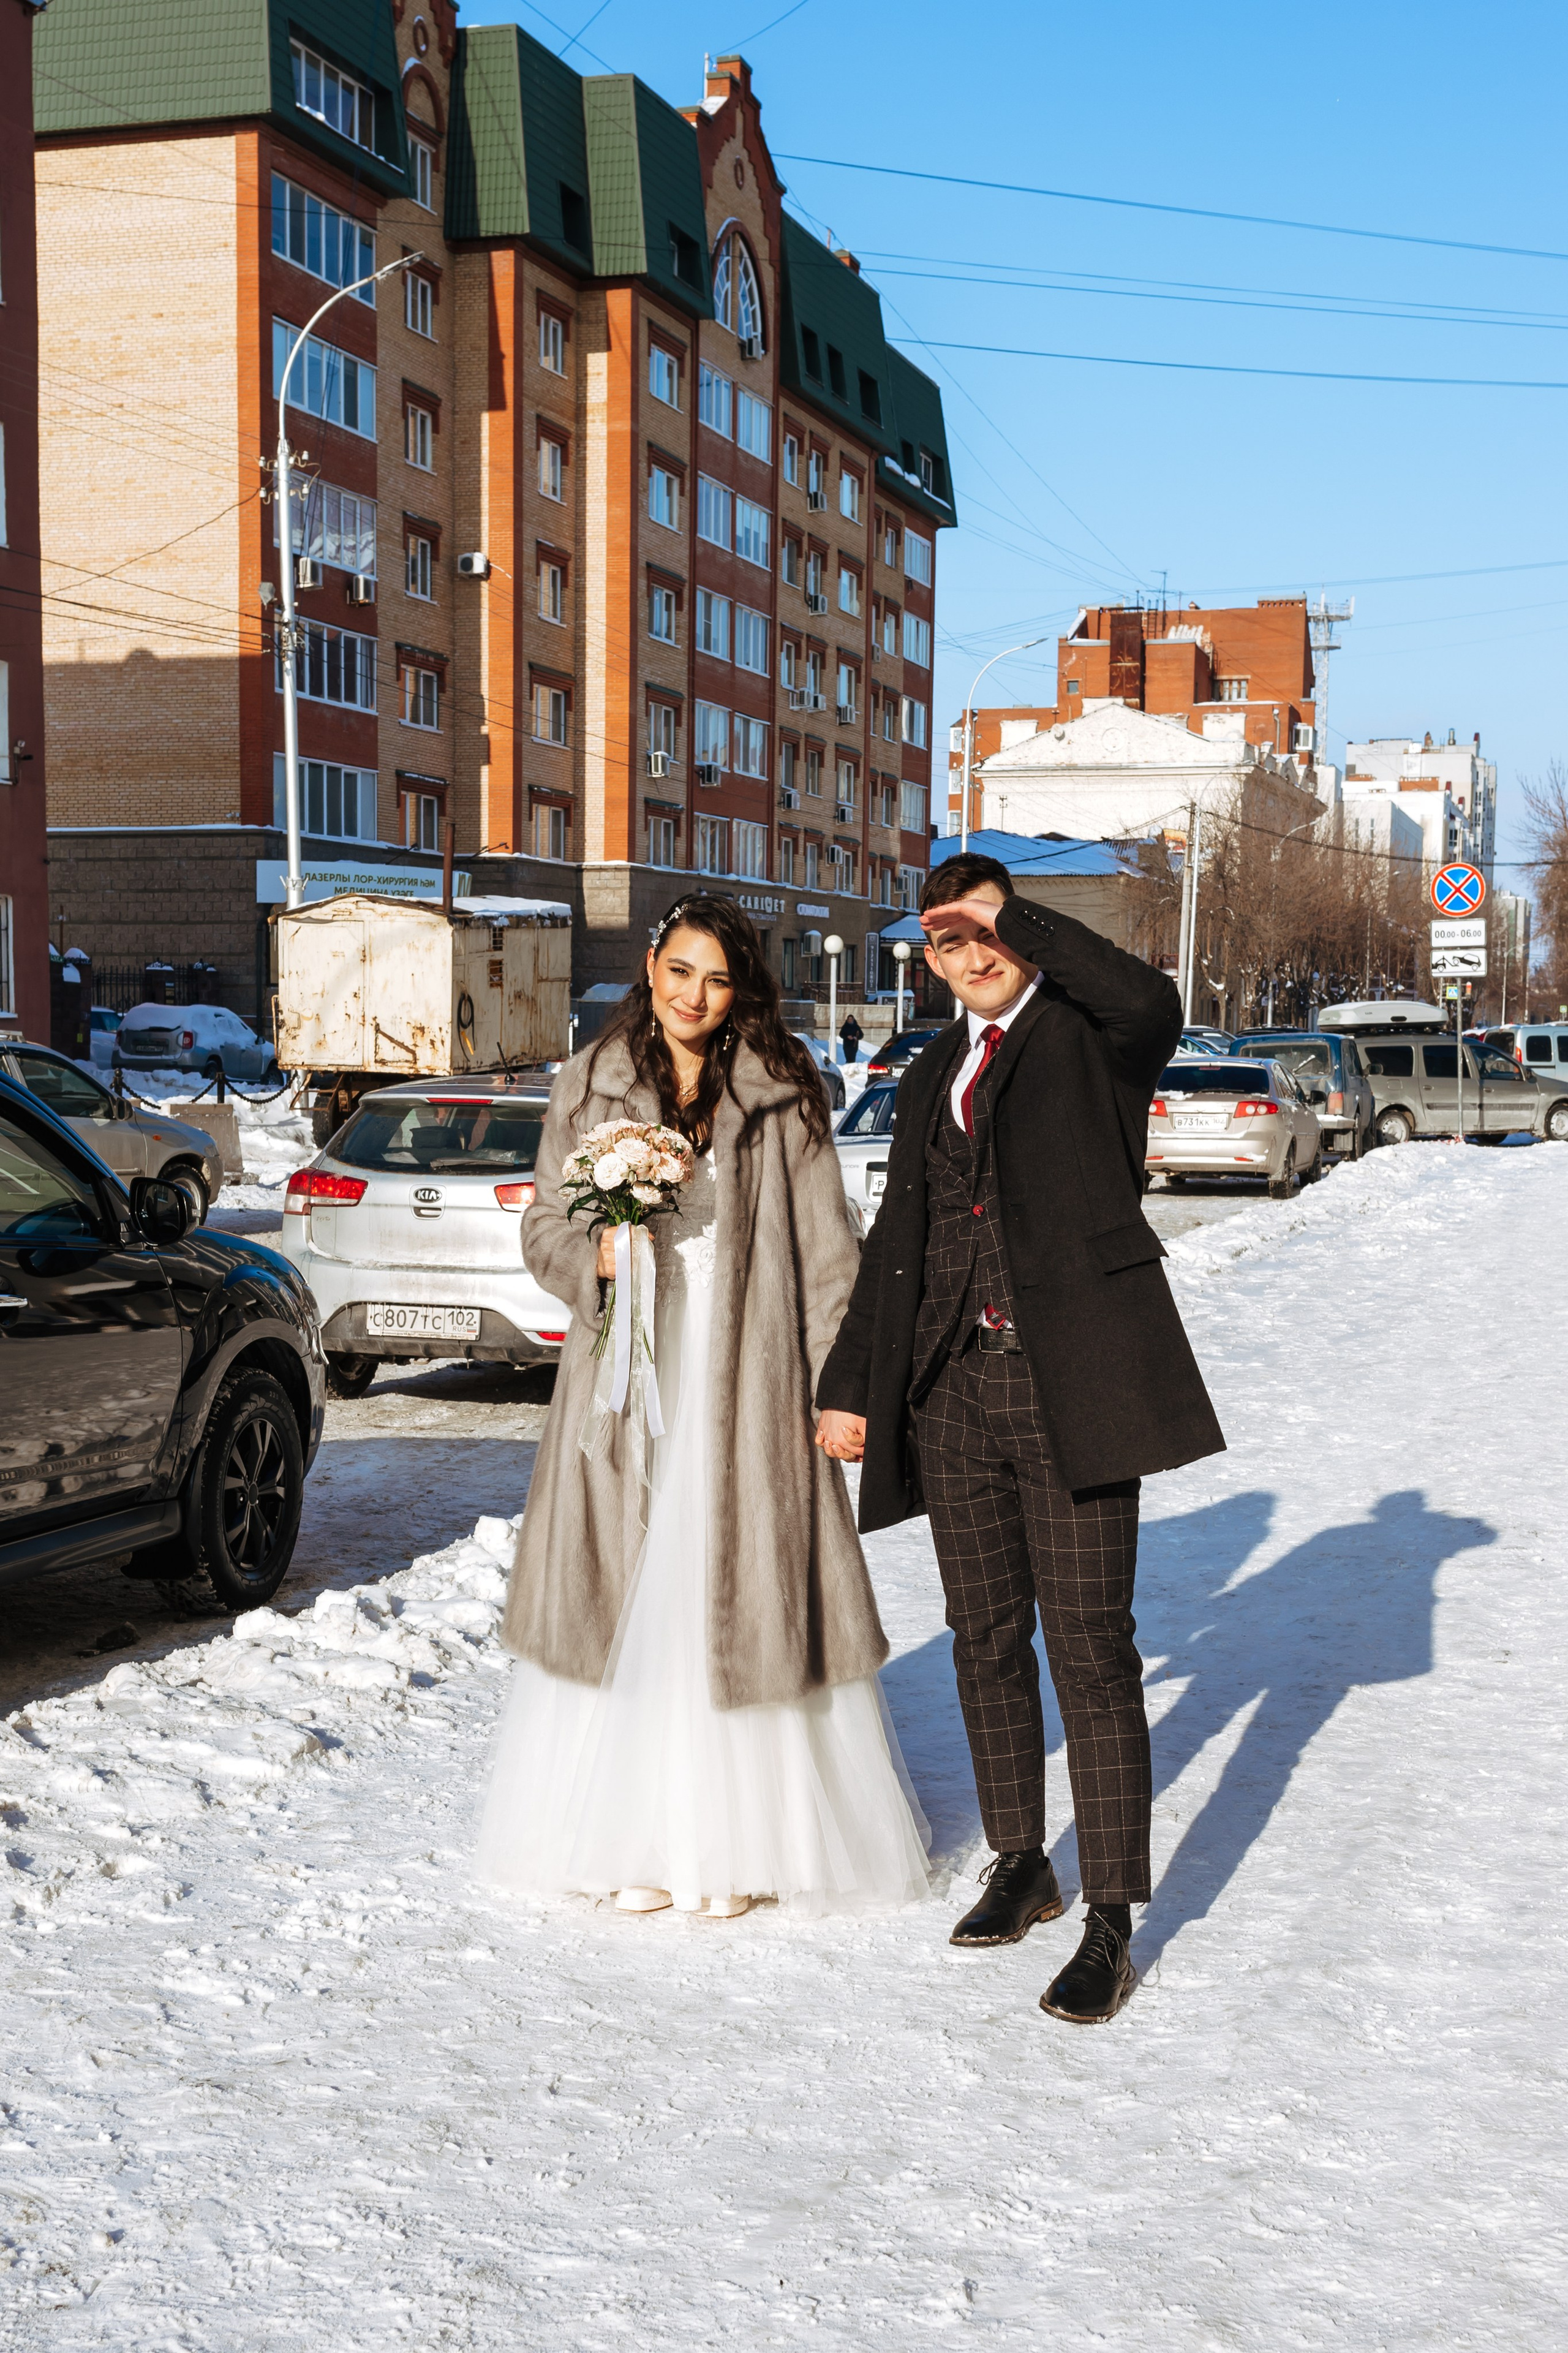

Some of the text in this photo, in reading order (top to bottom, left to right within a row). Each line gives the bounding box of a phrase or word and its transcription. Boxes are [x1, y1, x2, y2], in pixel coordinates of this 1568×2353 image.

[304, 873, 350, 882] ЛАЗЕРЛЫ
[353, 875, 418, 887] ЛОР-ХИРУРГИЯ
[418, 1191, 437, 1200] KIA
[448, 1310, 475, 1326] 102
